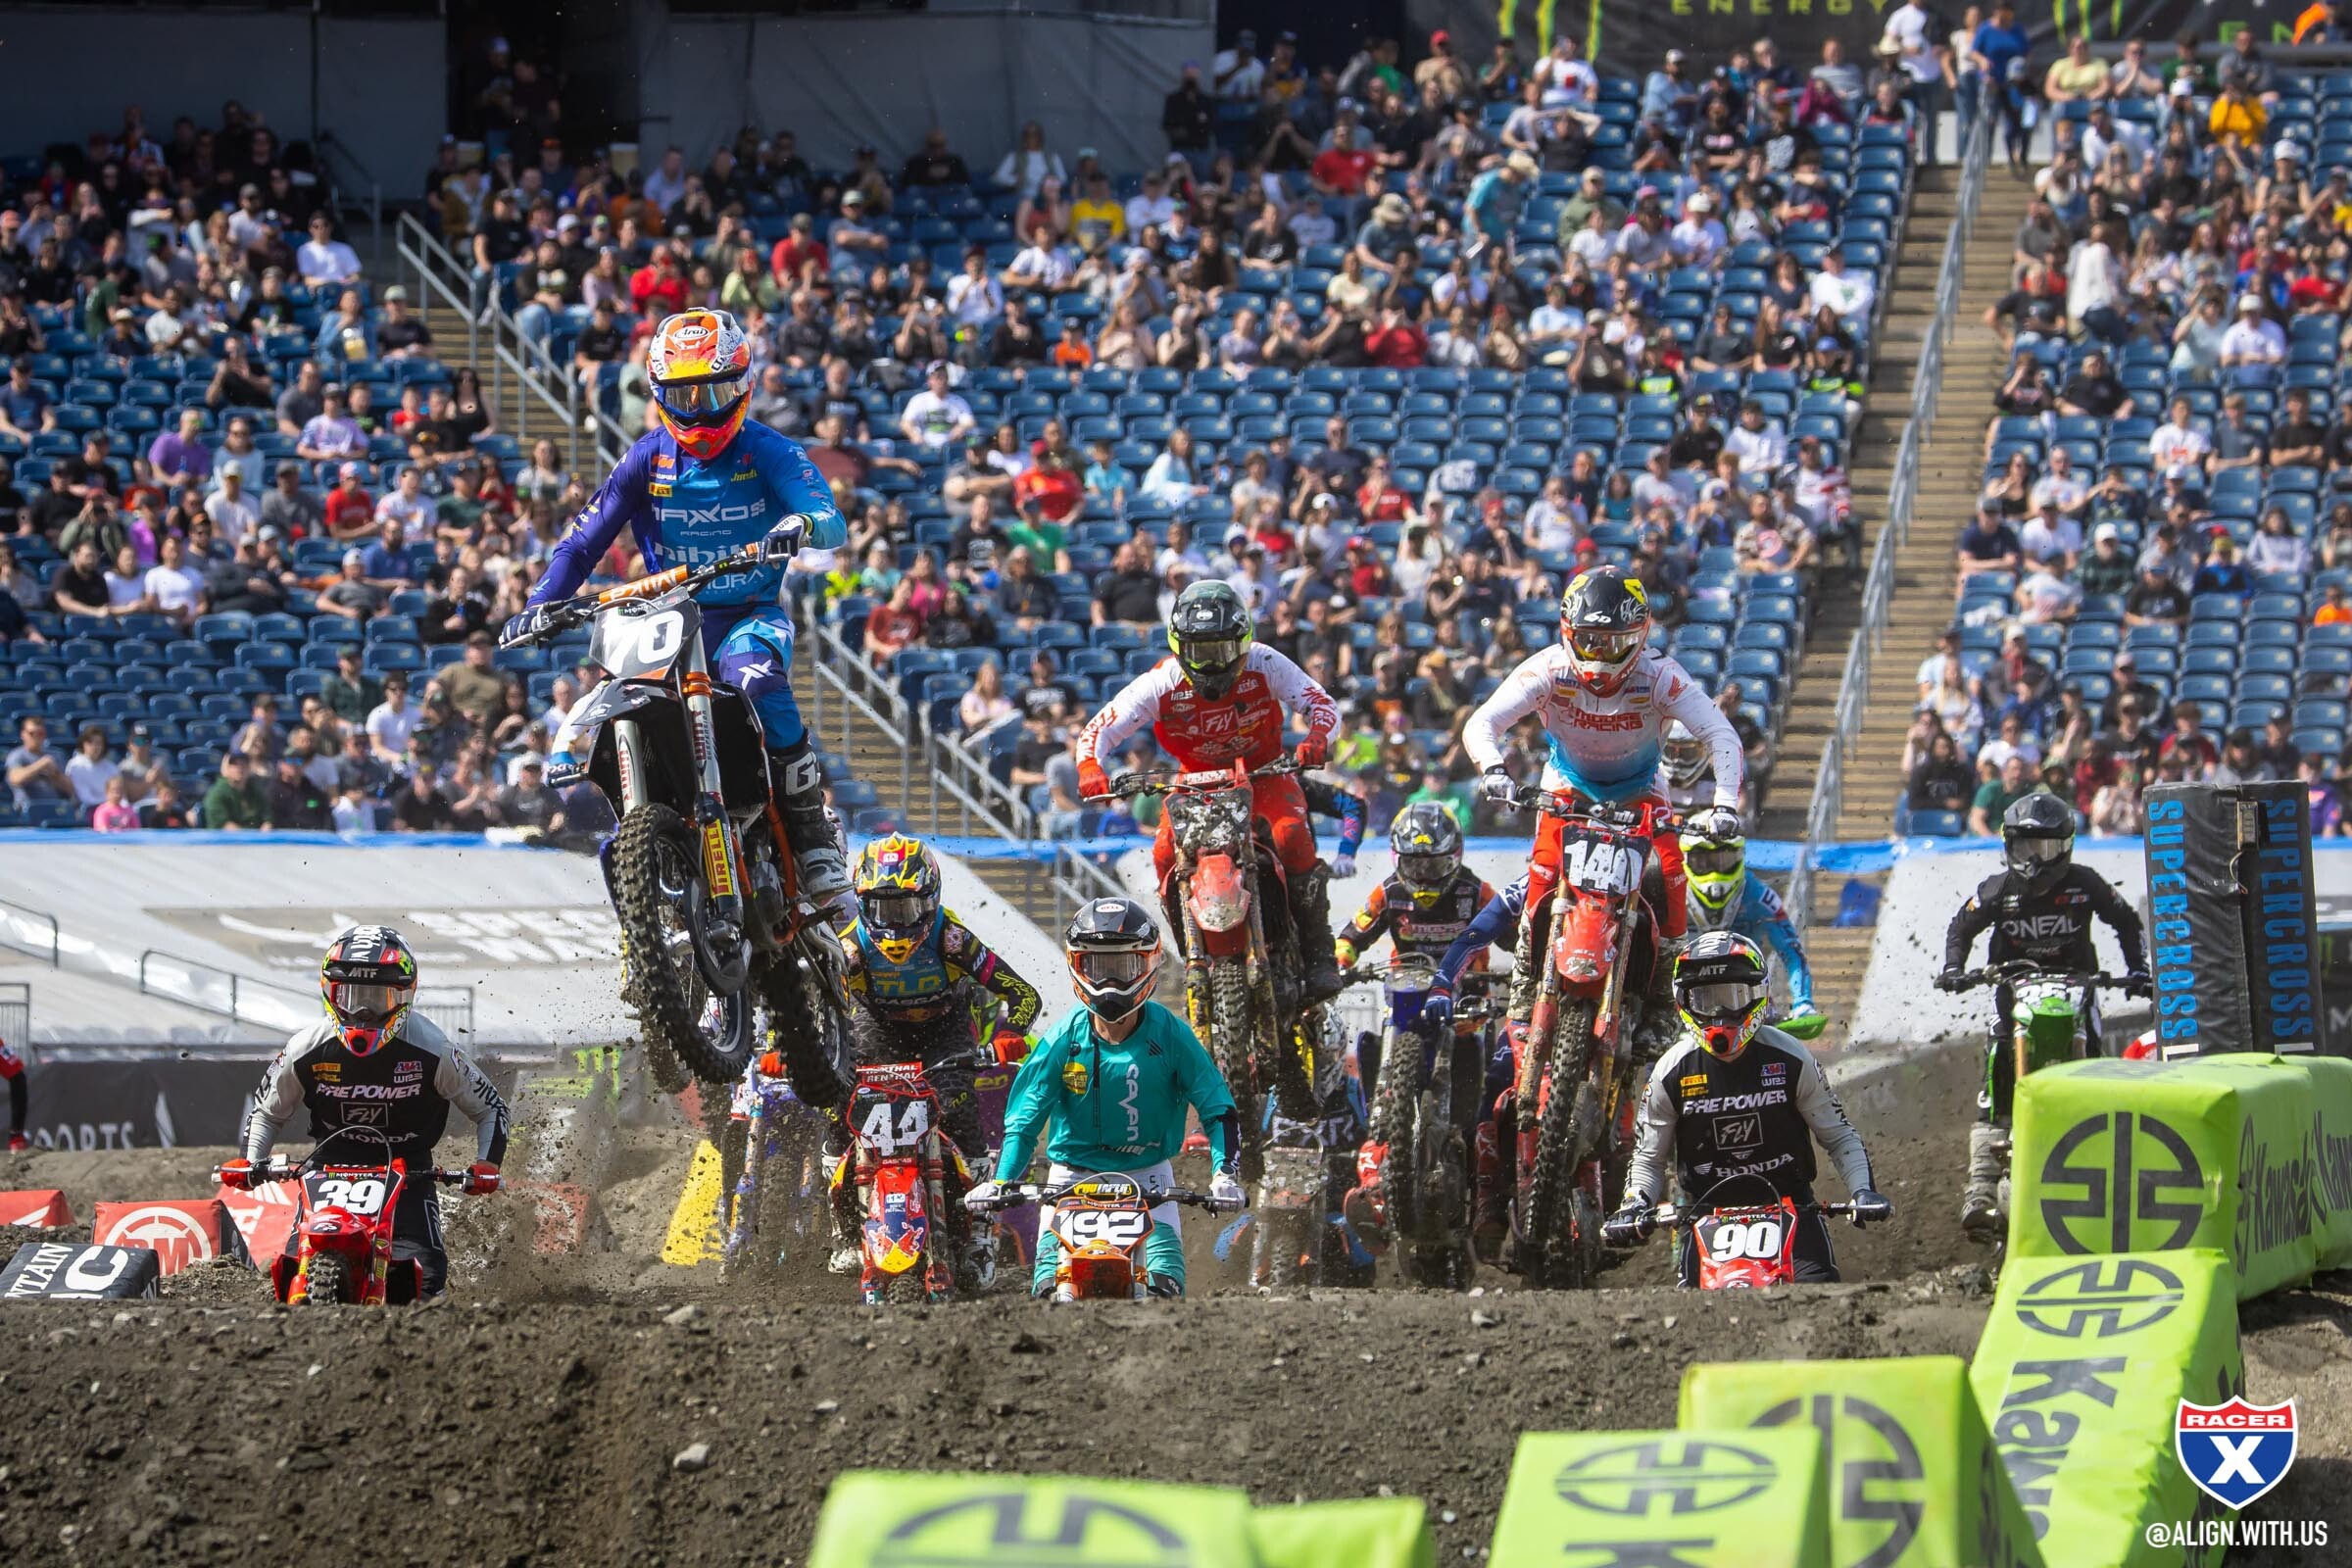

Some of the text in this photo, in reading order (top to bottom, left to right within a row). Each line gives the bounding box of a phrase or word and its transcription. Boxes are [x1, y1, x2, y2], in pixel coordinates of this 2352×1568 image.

[601, 610, 684, 675] 70
[1205, 710, 1233, 733] FLY
[1574, 717, 1643, 732] RACING
[1575, 708, 1642, 722] MOOSE
[706, 822, 730, 894] PIRELLI
[1564, 840, 1643, 895] 140
[2149, 800, 2199, 1039] SUPERCROSS
[2262, 799, 2315, 1037] SUPERCROSS
[1698, 964, 1728, 977] MTF
[352, 1084, 421, 1100] POWER
[1723, 1090, 1788, 1111] POWER
[346, 1106, 383, 1124] FLY
[859, 1101, 928, 1156] 44
[1720, 1118, 1756, 1145] FLY
[1715, 1152, 1794, 1177] HONDA
[313, 1180, 385, 1215] 39
[1056, 1210, 1145, 1247] 192
[1711, 1222, 1780, 1262] 90
